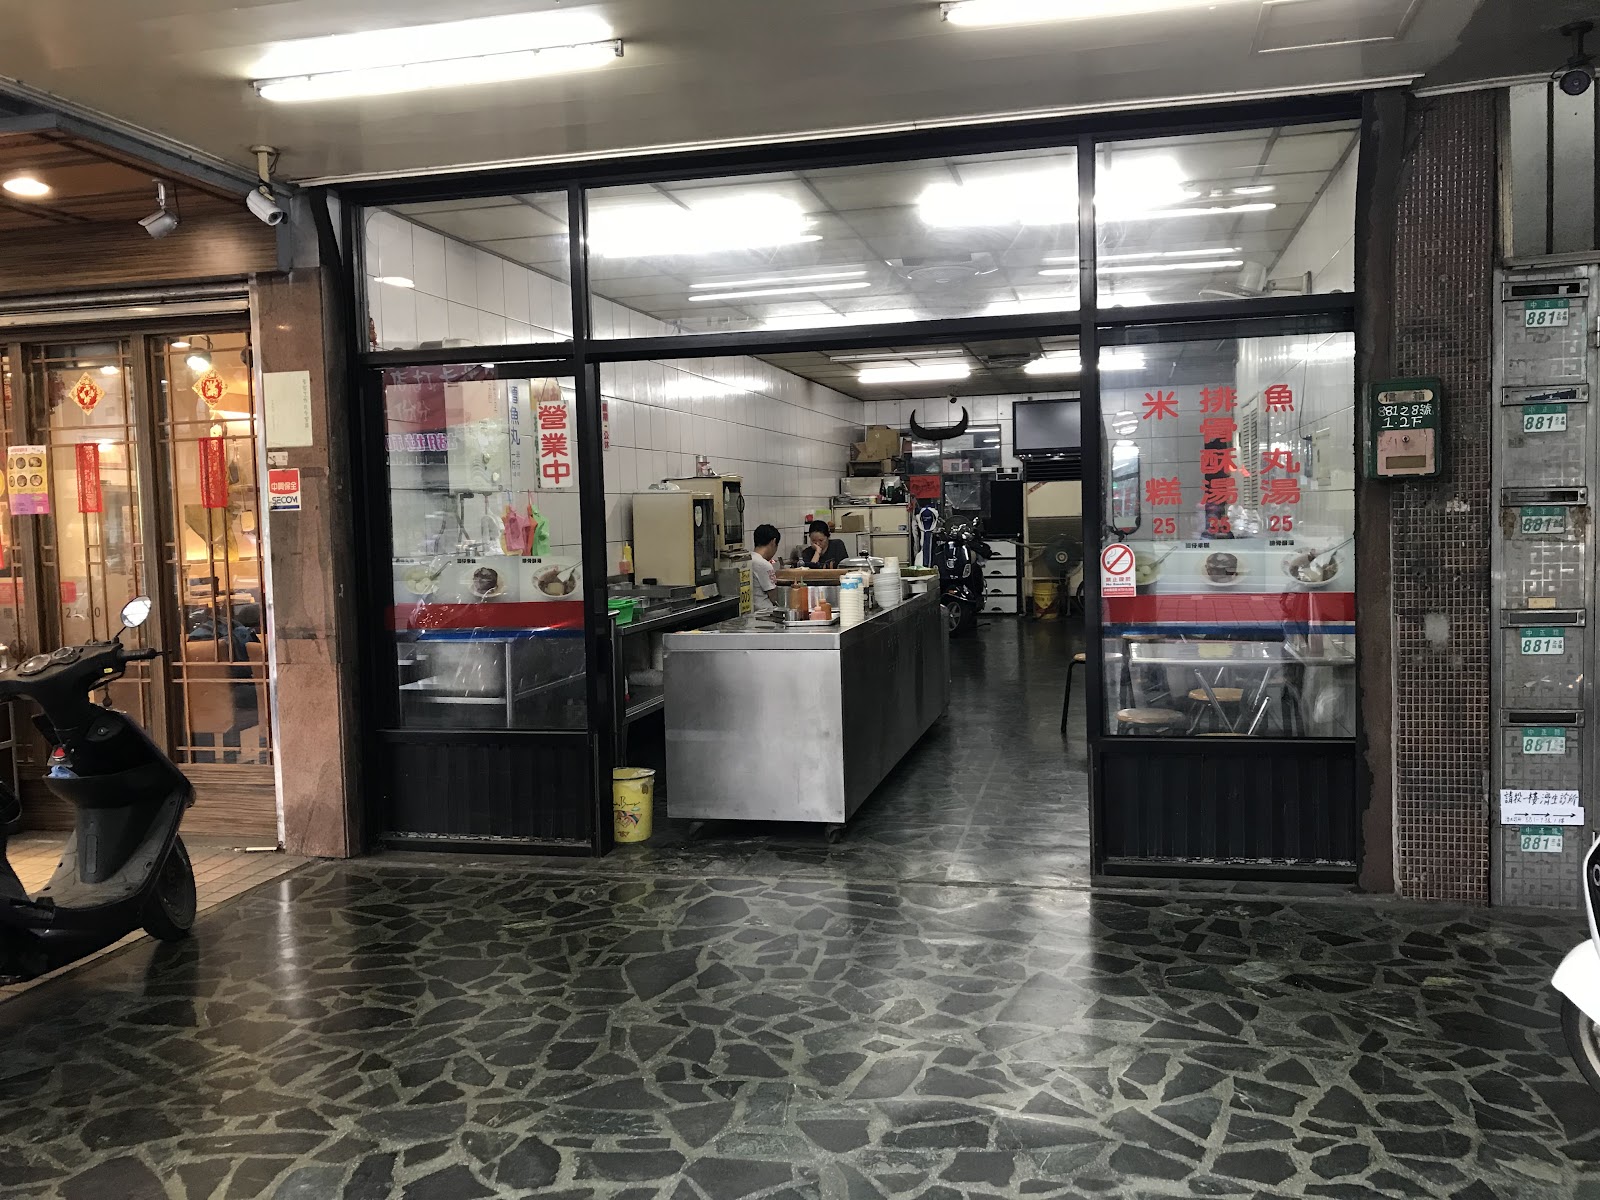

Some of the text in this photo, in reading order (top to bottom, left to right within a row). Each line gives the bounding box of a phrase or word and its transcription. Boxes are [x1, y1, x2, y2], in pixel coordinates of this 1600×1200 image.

[1526, 311, 1556, 326] 881
[1525, 415, 1554, 430] 881
[538, 404, 571, 485] 營業中
[1199, 386, 1238, 506] 排骨酥湯
[1142, 390, 1183, 535] 米糕 25
[1260, 384, 1301, 532] 魚丸湯 25
[271, 496, 298, 505] SECOM
[1522, 639, 1551, 653] 881
[1522, 837, 1550, 850] 881
